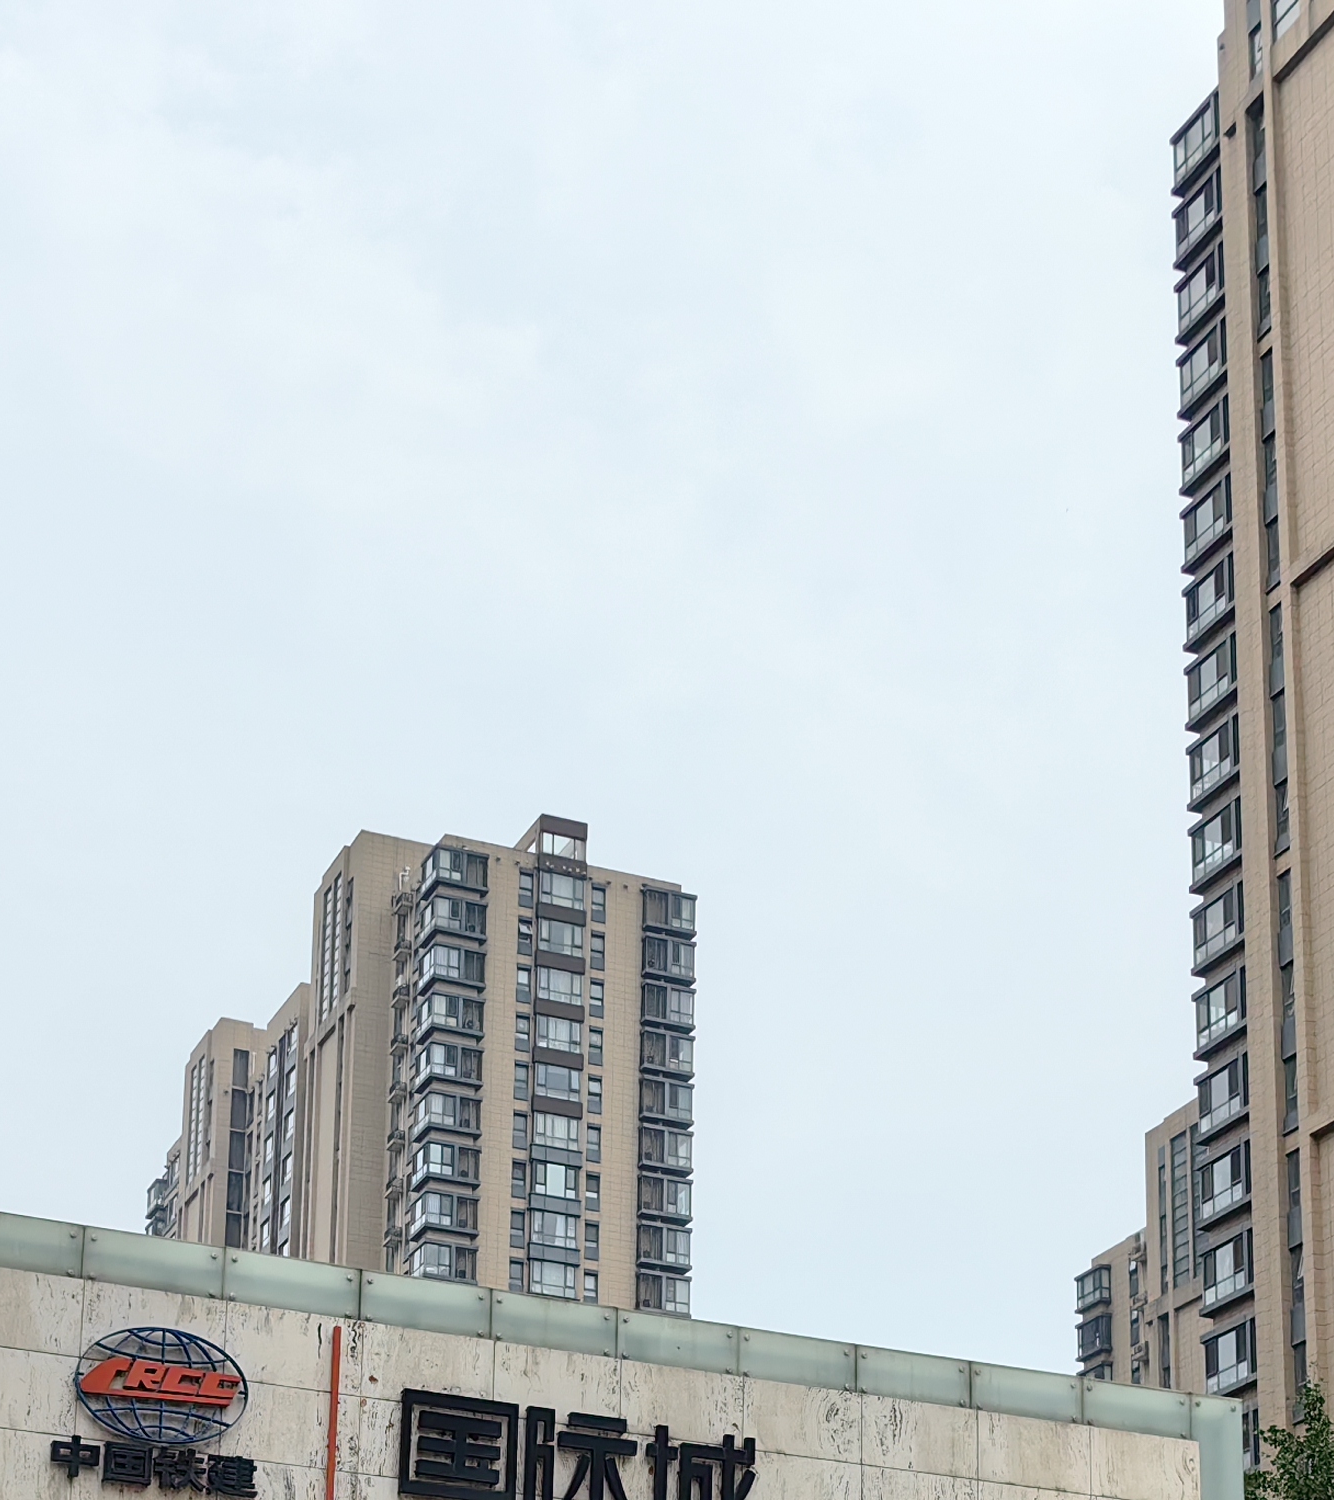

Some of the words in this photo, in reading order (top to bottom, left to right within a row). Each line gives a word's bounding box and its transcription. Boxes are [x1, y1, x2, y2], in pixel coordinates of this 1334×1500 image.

[80, 1357, 242, 1408] CRCC
[50, 1434, 258, 1499] 中国铁建
